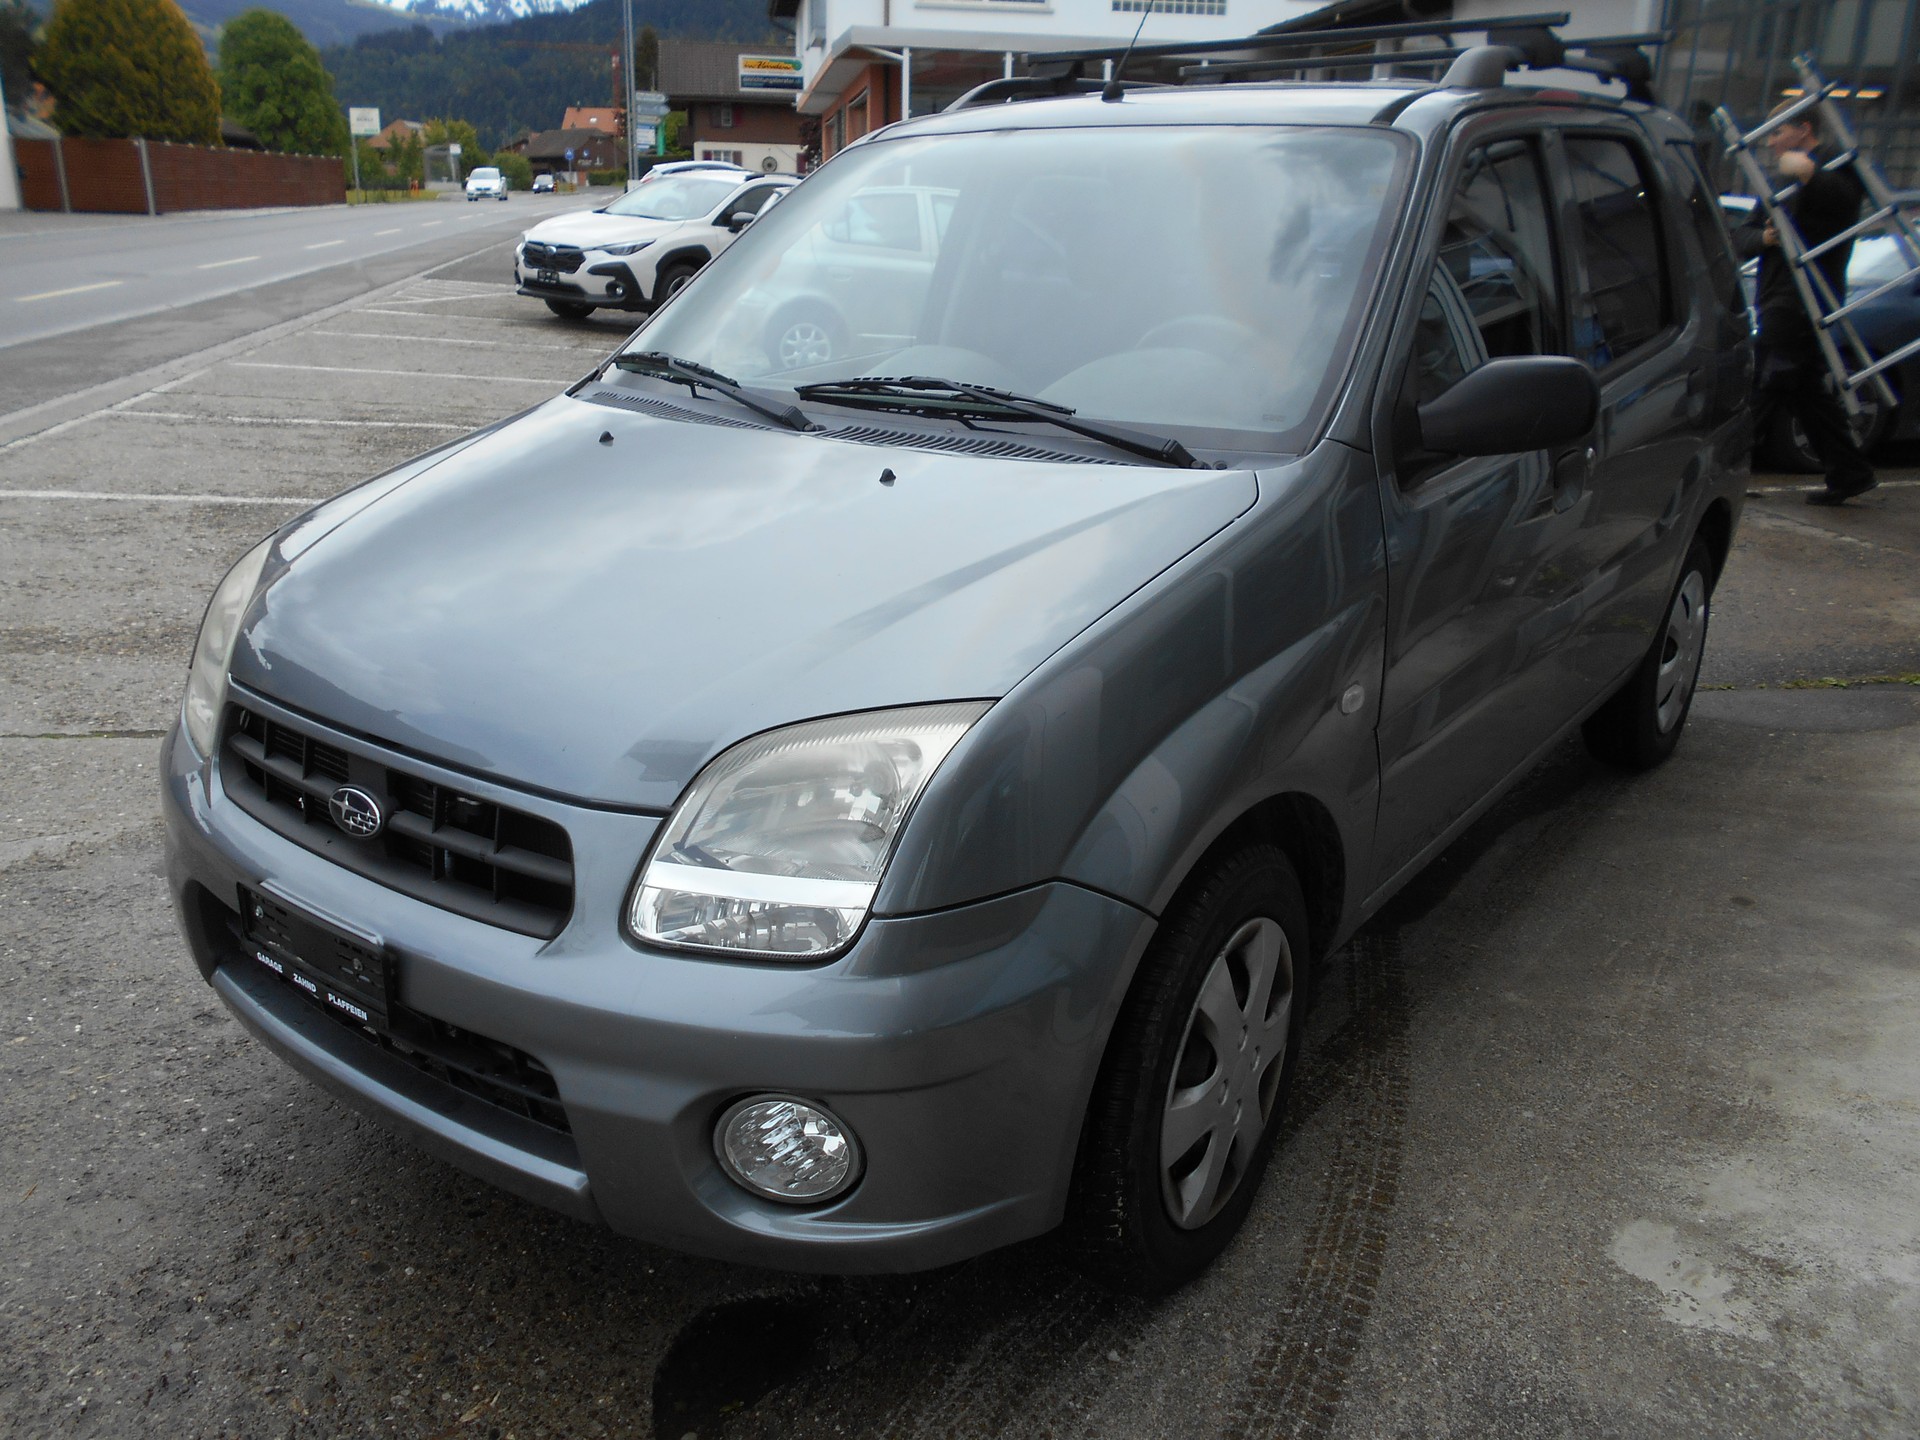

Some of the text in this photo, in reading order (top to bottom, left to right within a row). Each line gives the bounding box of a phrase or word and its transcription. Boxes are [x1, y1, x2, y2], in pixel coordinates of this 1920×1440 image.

[256, 951, 368, 1021] GARAGE ZAHND PLAFFEIEN
